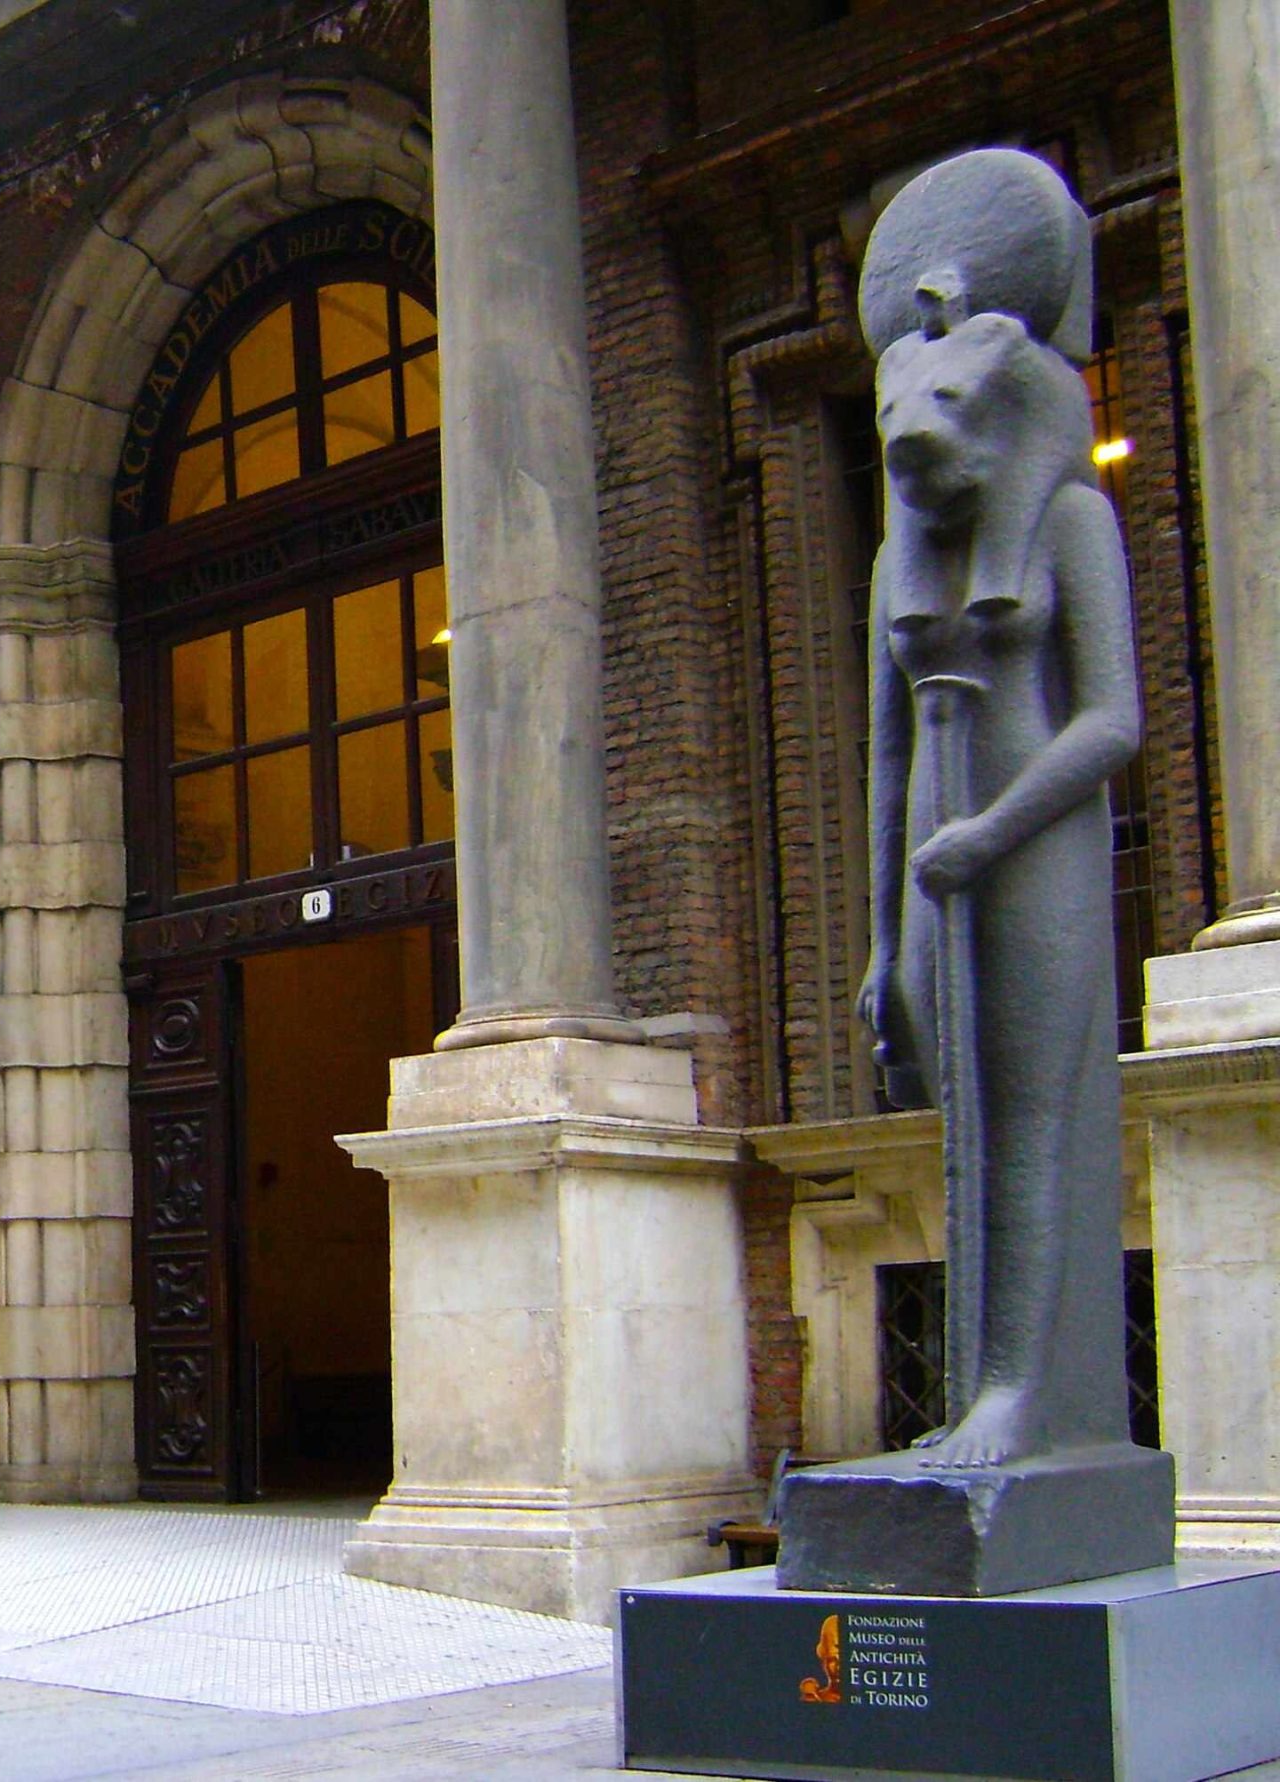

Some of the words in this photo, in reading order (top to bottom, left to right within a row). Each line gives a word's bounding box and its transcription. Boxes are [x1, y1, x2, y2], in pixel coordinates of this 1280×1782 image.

[116, 241, 280, 515] ACCADEMIA
[311, 896, 321, 915] 6
[158, 896, 298, 948] MVSEO
[847, 1615, 925, 1628] FONDAZIONE
[849, 1632, 895, 1645] MUSEO
[850, 1650, 926, 1665] ANTICHITÀ
[850, 1668, 927, 1688] EGIZIE
[865, 1691, 928, 1708] TORINO
